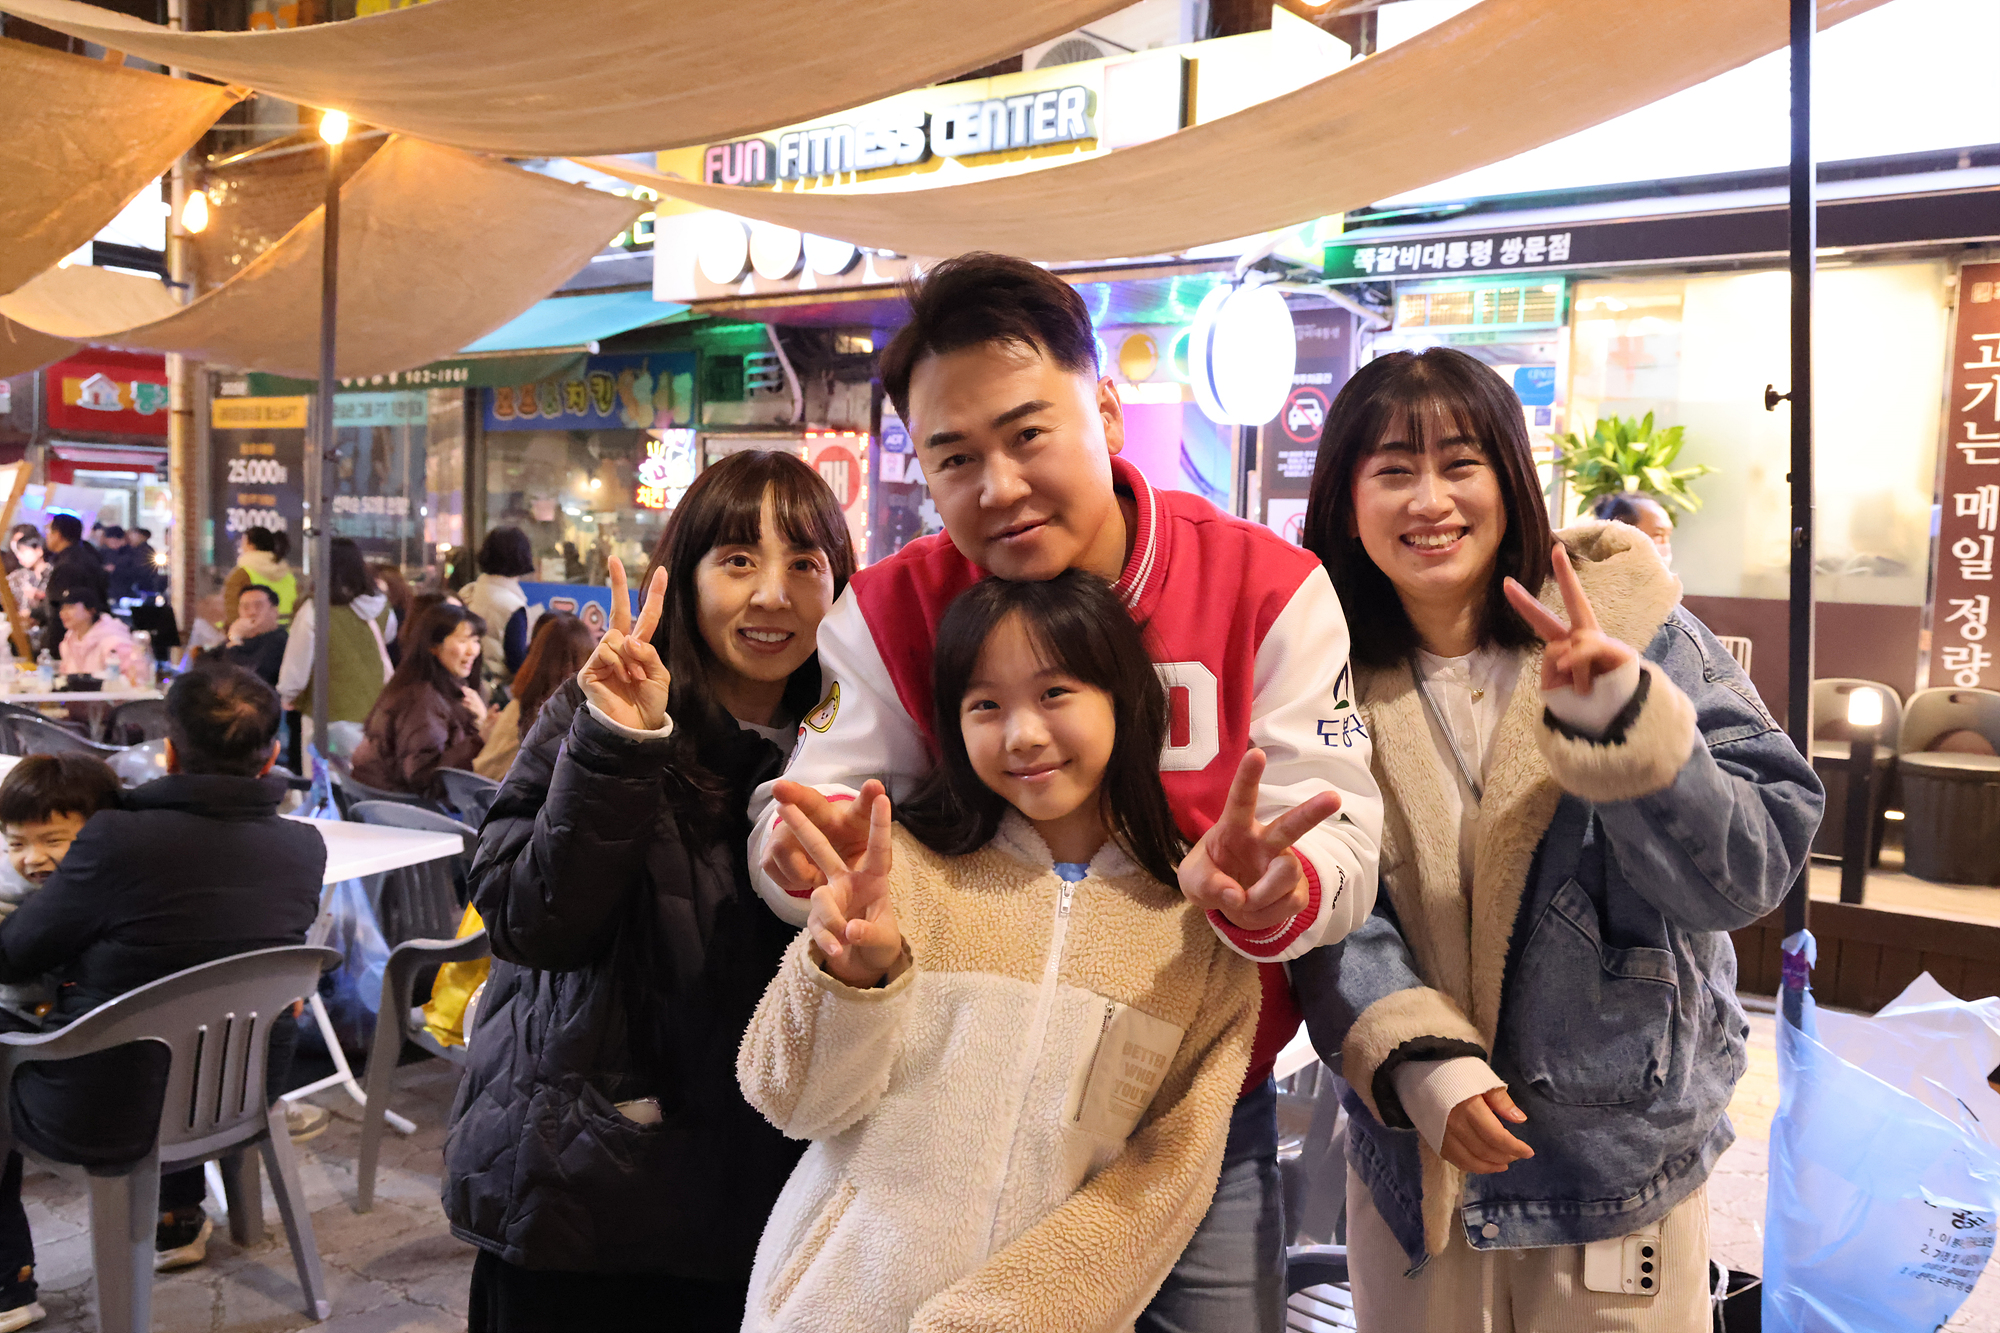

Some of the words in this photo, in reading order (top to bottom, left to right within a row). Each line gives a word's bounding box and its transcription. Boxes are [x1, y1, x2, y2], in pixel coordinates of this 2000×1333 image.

[705, 138, 768, 185] FUN
[779, 118, 926, 178] FITNESS
[930, 85, 1089, 157] CENTER
[1352, 239, 1493, 273] 쪽갈비대통령
[1499, 232, 1572, 265] 쌍문점
[1956, 332, 2000, 466] 고기는
[636, 485, 665, 509] 치킨
[1951, 484, 2000, 581] 매일
[1941, 594, 1992, 688] 정량
[1151, 661, 1219, 772] D
